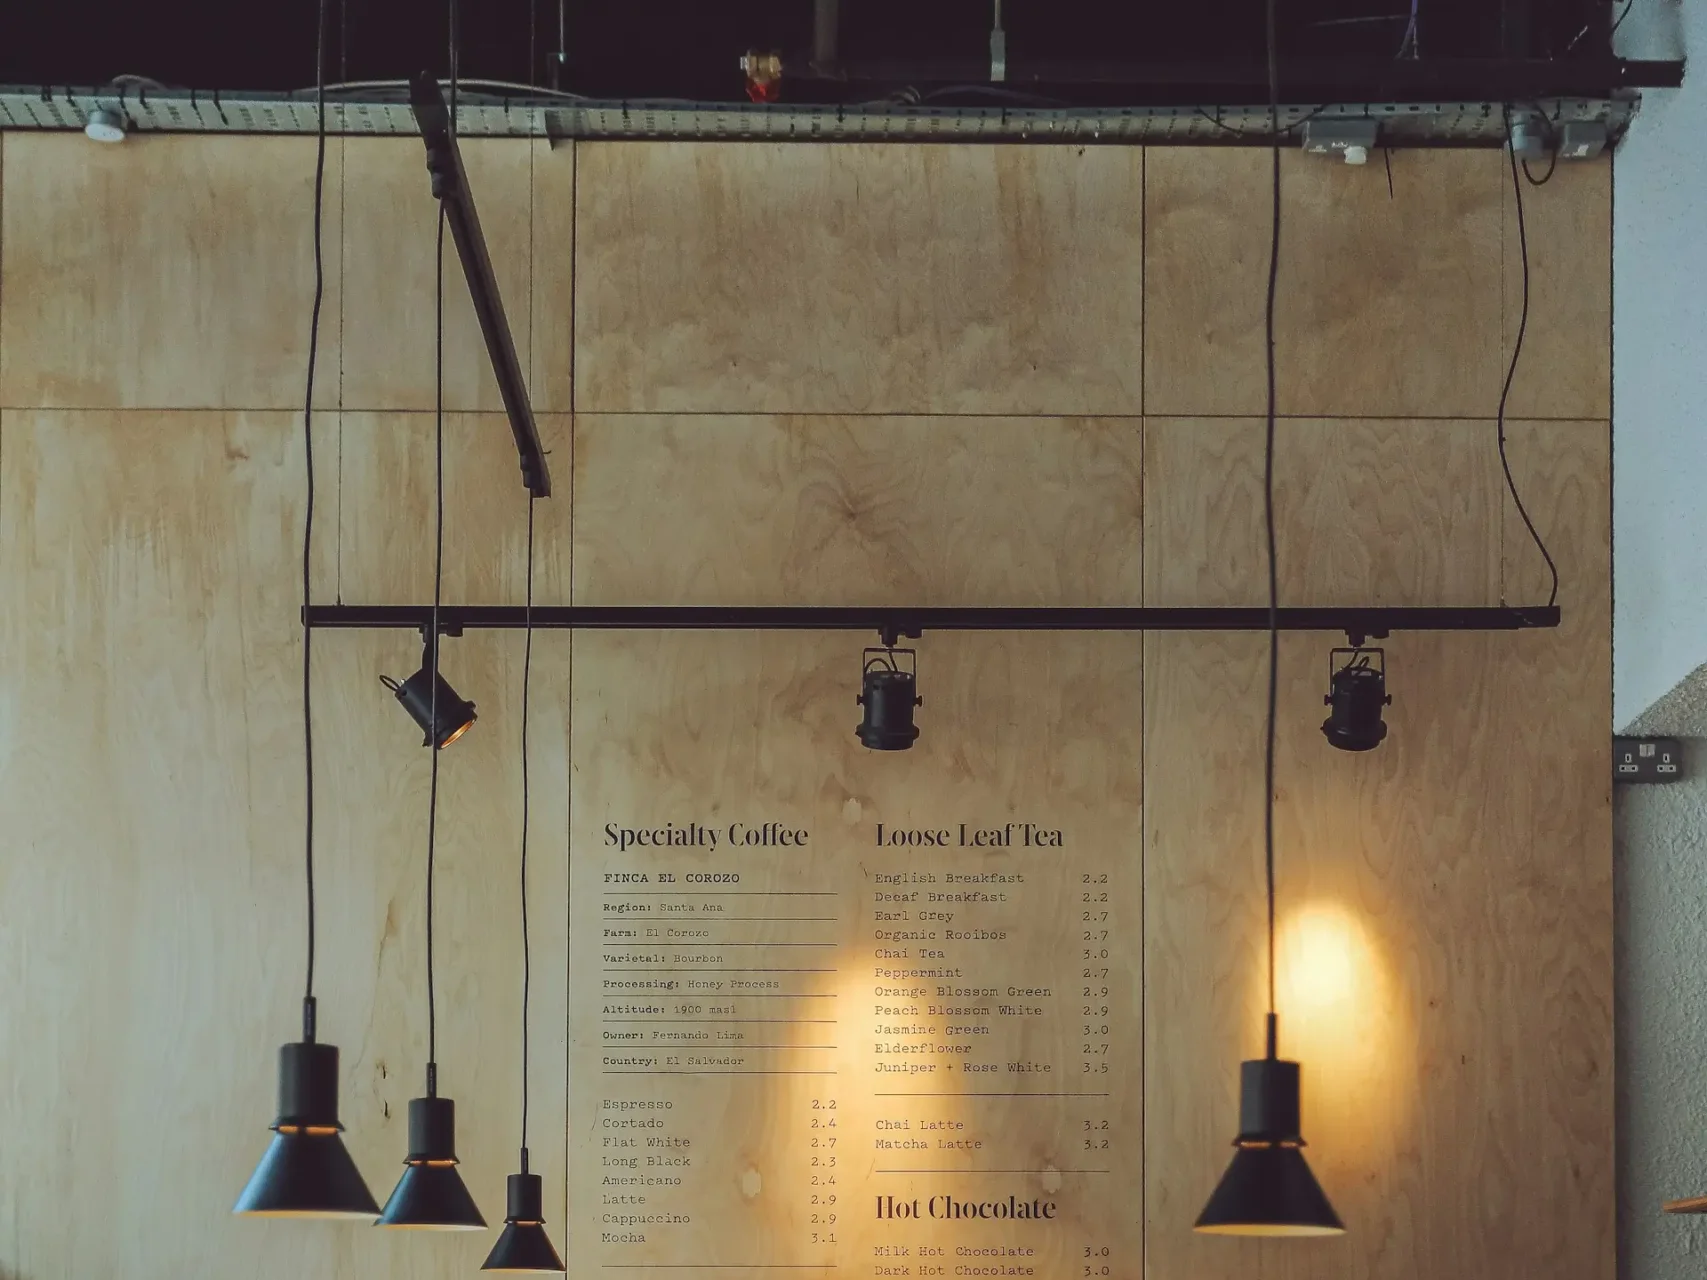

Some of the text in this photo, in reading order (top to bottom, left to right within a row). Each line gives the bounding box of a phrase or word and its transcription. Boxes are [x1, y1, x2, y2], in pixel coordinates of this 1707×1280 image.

[605, 823, 808, 851] Specialty Coffee
[876, 823, 1062, 846] Loose Leaf Tea
[604, 874, 739, 883] FINCA EL COROZO
[876, 873, 1024, 885] English Breakfast
[1083, 874, 1107, 883] 2.2
[875, 892, 1006, 902] Decaf Breakfast
[1083, 893, 1107, 902] 2.2
[604, 903, 650, 913] Region:
[875, 911, 954, 923] Earl Grey
[1083, 911, 1108, 922] 2.7
[604, 929, 636, 937] Farm:
[667, 928, 708, 937] Corozo
[875, 930, 1006, 942] Organic Rooibos
[1084, 931, 1108, 941] 2.7
[603, 954, 664, 962] Varietal:
[875, 949, 944, 958] Chai Tea
[1084, 949, 1108, 959] 3.0
[875, 968, 962, 979] Peppermint
[1083, 968, 1108, 979] 2.7
[603, 980, 779, 990] Processing: Honey Process
[875, 986, 1051, 998] Orange Blossom Green
[1083, 987, 1108, 997] 2.9
[603, 1005, 664, 1013] Altitude:
[709, 1005, 736, 1014] masl
[875, 1005, 1042, 1015] Peach Blossom White
[1084, 1006, 1108, 1016] 2.9
[652, 1031, 708, 1039] Fernando
[717, 1031, 744, 1039] Lima
[875, 1025, 989, 1035] Jasmine Green
[1084, 1025, 1108, 1035] 3.0
[875, 1043, 971, 1053] Elderflower
[1083, 1044, 1108, 1054] 2.7
[603, 1057, 744, 1066] Country: El Salvador
[875, 1062, 936, 1075] Juniper
[964, 1063, 997, 1072] Rose
[1008, 1062, 1051, 1073] White
[1084, 1063, 1108, 1073] 3.5
[603, 1100, 672, 1111] Espresso
[812, 1100, 836, 1109] 2.2
[603, 1118, 663, 1128] Cortado
[811, 1118, 836, 1128] 2.4
[876, 1120, 963, 1130] Chai Latte
[1084, 1120, 1108, 1131] 3.2
[603, 1137, 690, 1147] Flat White
[811, 1138, 836, 1148] 2.7
[876, 1139, 981, 1149] Matcha Latte
[1085, 1140, 1108, 1149] 3.2
[602, 1156, 690, 1169] Long Black
[811, 1157, 836, 1167] 2.3
[602, 1175, 681, 1185] Americano
[811, 1176, 836, 1185] 2.4
[603, 1194, 645, 1204] Latte
[811, 1195, 836, 1205] 2.9
[877, 1196, 1055, 1218] Hot Chocolate
[603, 1213, 690, 1225] Cappuccino
[811, 1214, 836, 1224] 2.9
[602, 1232, 646, 1242] Mocha
[812, 1233, 836, 1243] 3.1
[875, 1246, 1033, 1256] Milk Hot Chocolate
[1084, 1247, 1109, 1257] 3.0
[875, 1265, 1033, 1275] Dark Hot Chocolate
[1085, 1266, 1109, 1276] 3.0
